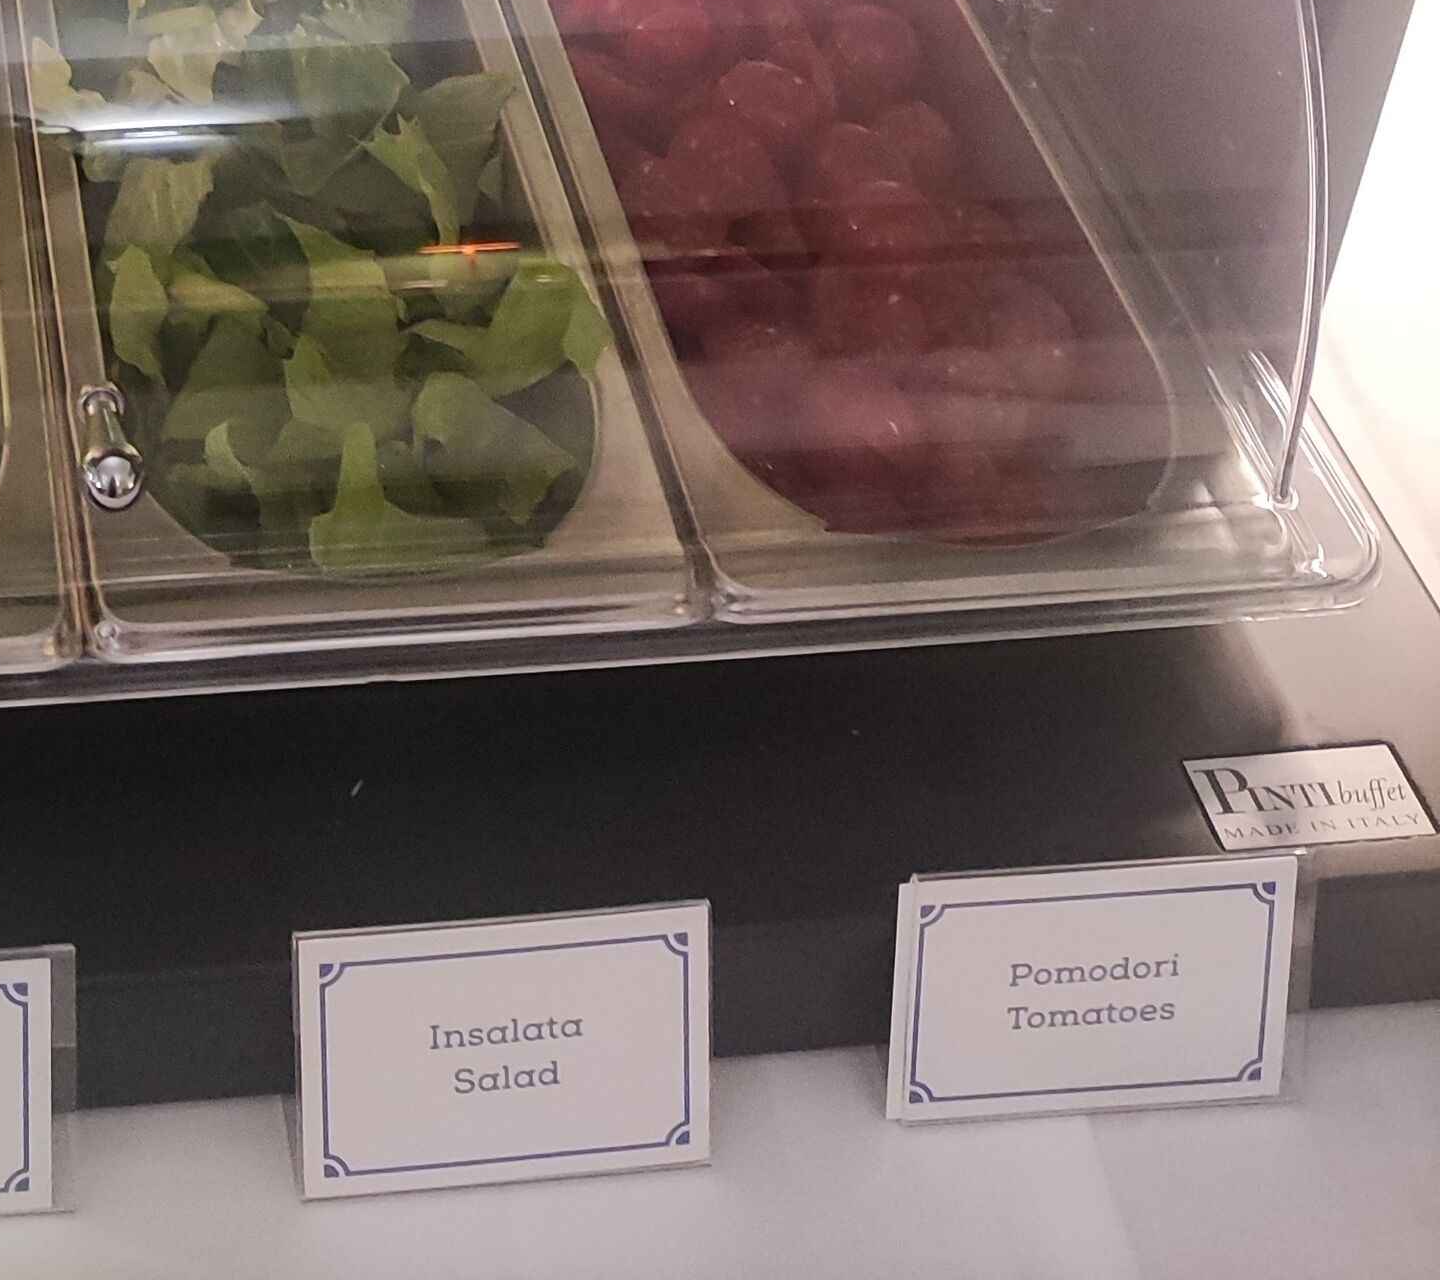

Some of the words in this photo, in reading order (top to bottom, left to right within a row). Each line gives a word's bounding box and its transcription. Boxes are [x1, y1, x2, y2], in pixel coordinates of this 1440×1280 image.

[1338, 777, 1407, 812] buffet
[1223, 822, 1300, 839] MADE
[1311, 819, 1337, 831] IN
[1348, 813, 1421, 830] ITALY
[1009, 953, 1180, 987] Pomodori
[1007, 1001, 1176, 1030] Tomatoes
[429, 1016, 584, 1050] Insalata
[453, 1061, 561, 1094] Salad
